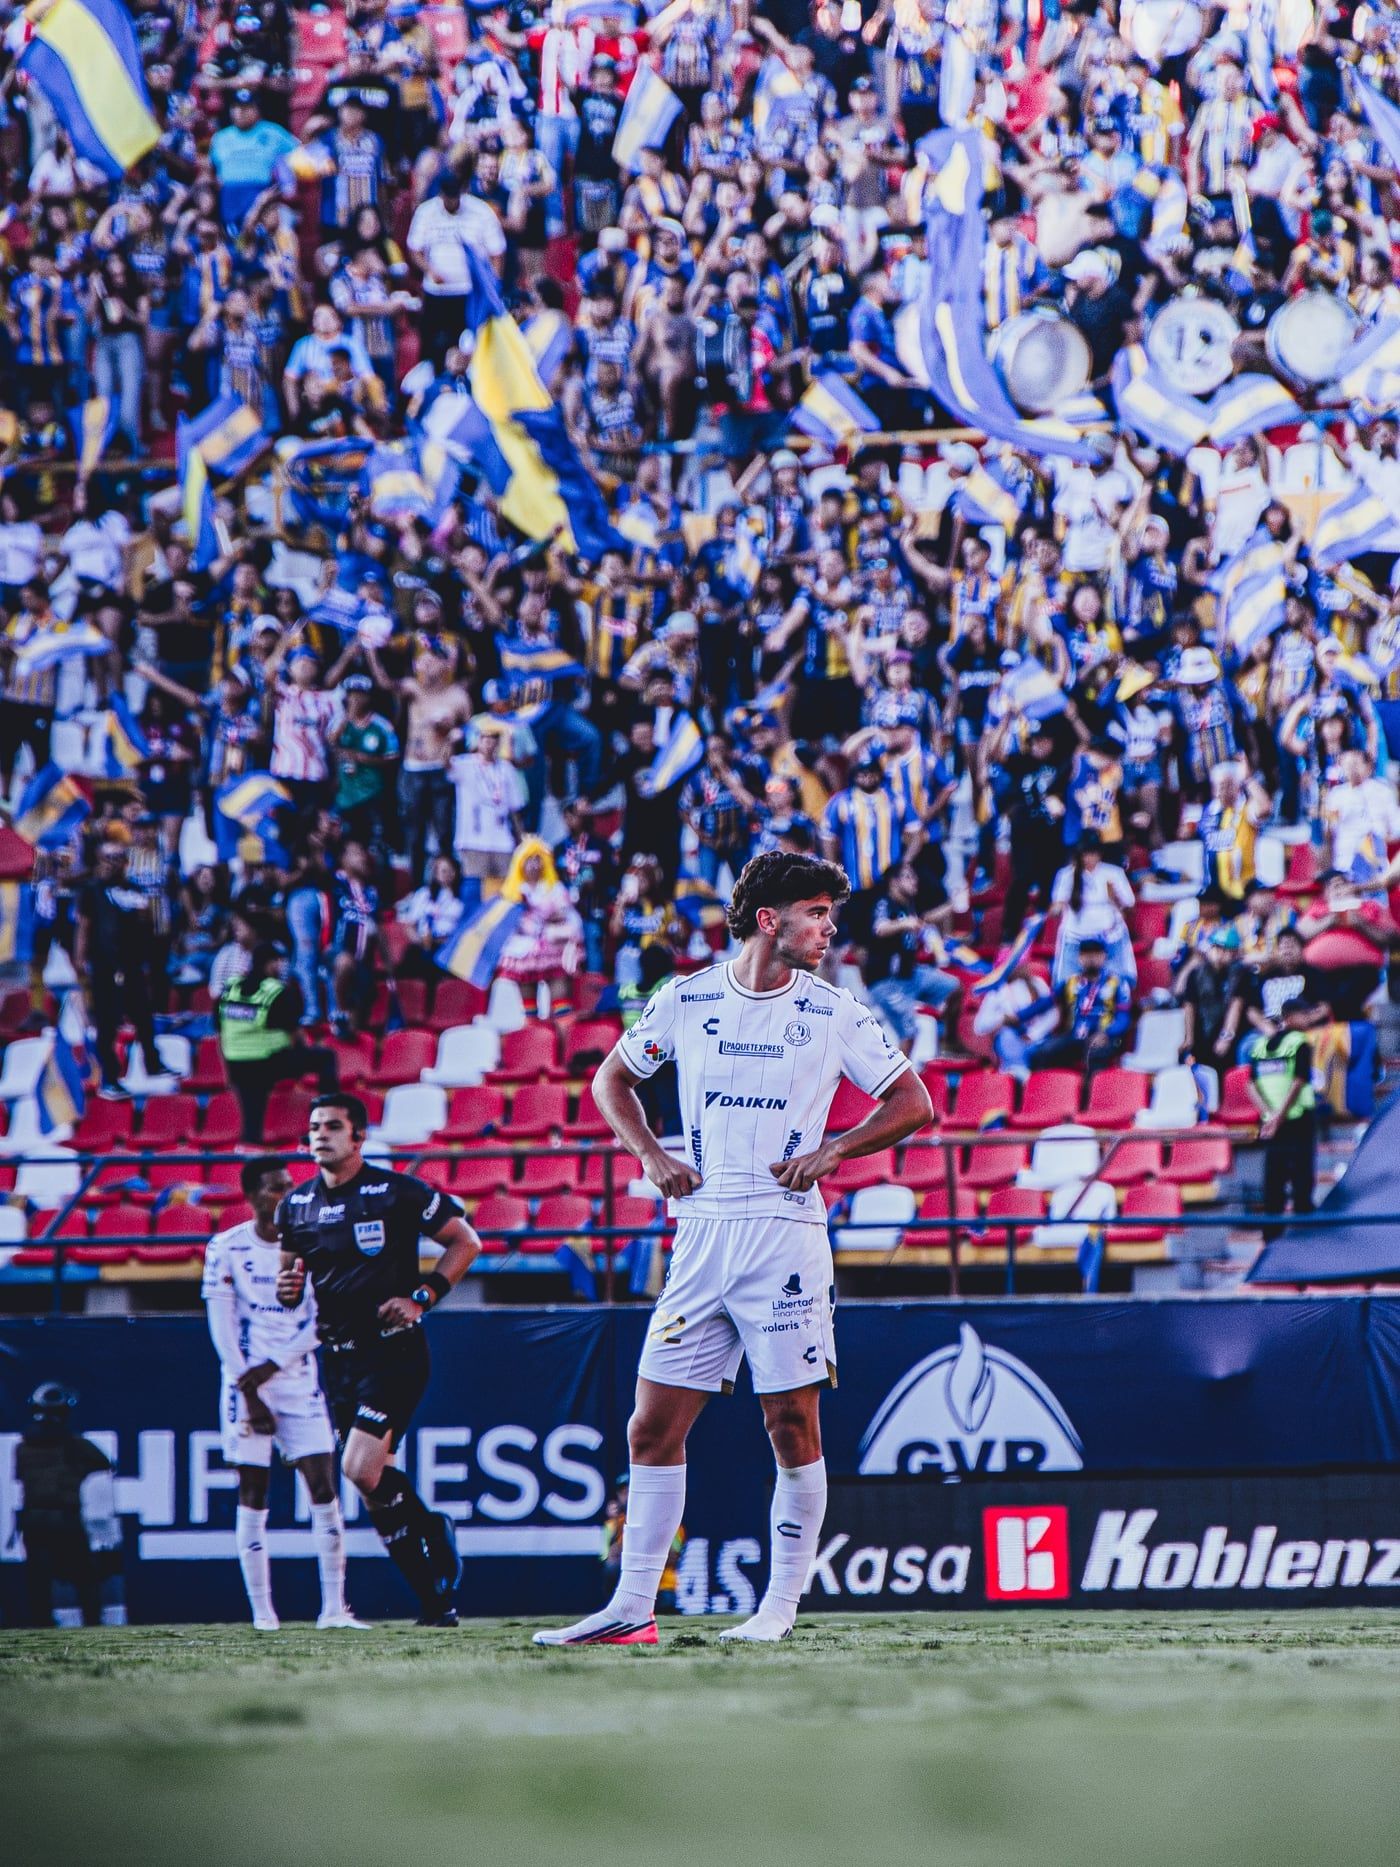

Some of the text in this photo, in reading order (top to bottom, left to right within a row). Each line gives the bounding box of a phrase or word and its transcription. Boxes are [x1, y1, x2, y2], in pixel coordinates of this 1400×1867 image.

[725, 1041, 785, 1053] PAQUETEXPRESS
[719, 1095, 787, 1110] DAIKIN
[772, 1296, 814, 1310] Libertad
[762, 1320, 800, 1333] volaris
[1080, 1508, 1400, 1592] Koblenz
[801, 1532, 972, 1595] Kasa
